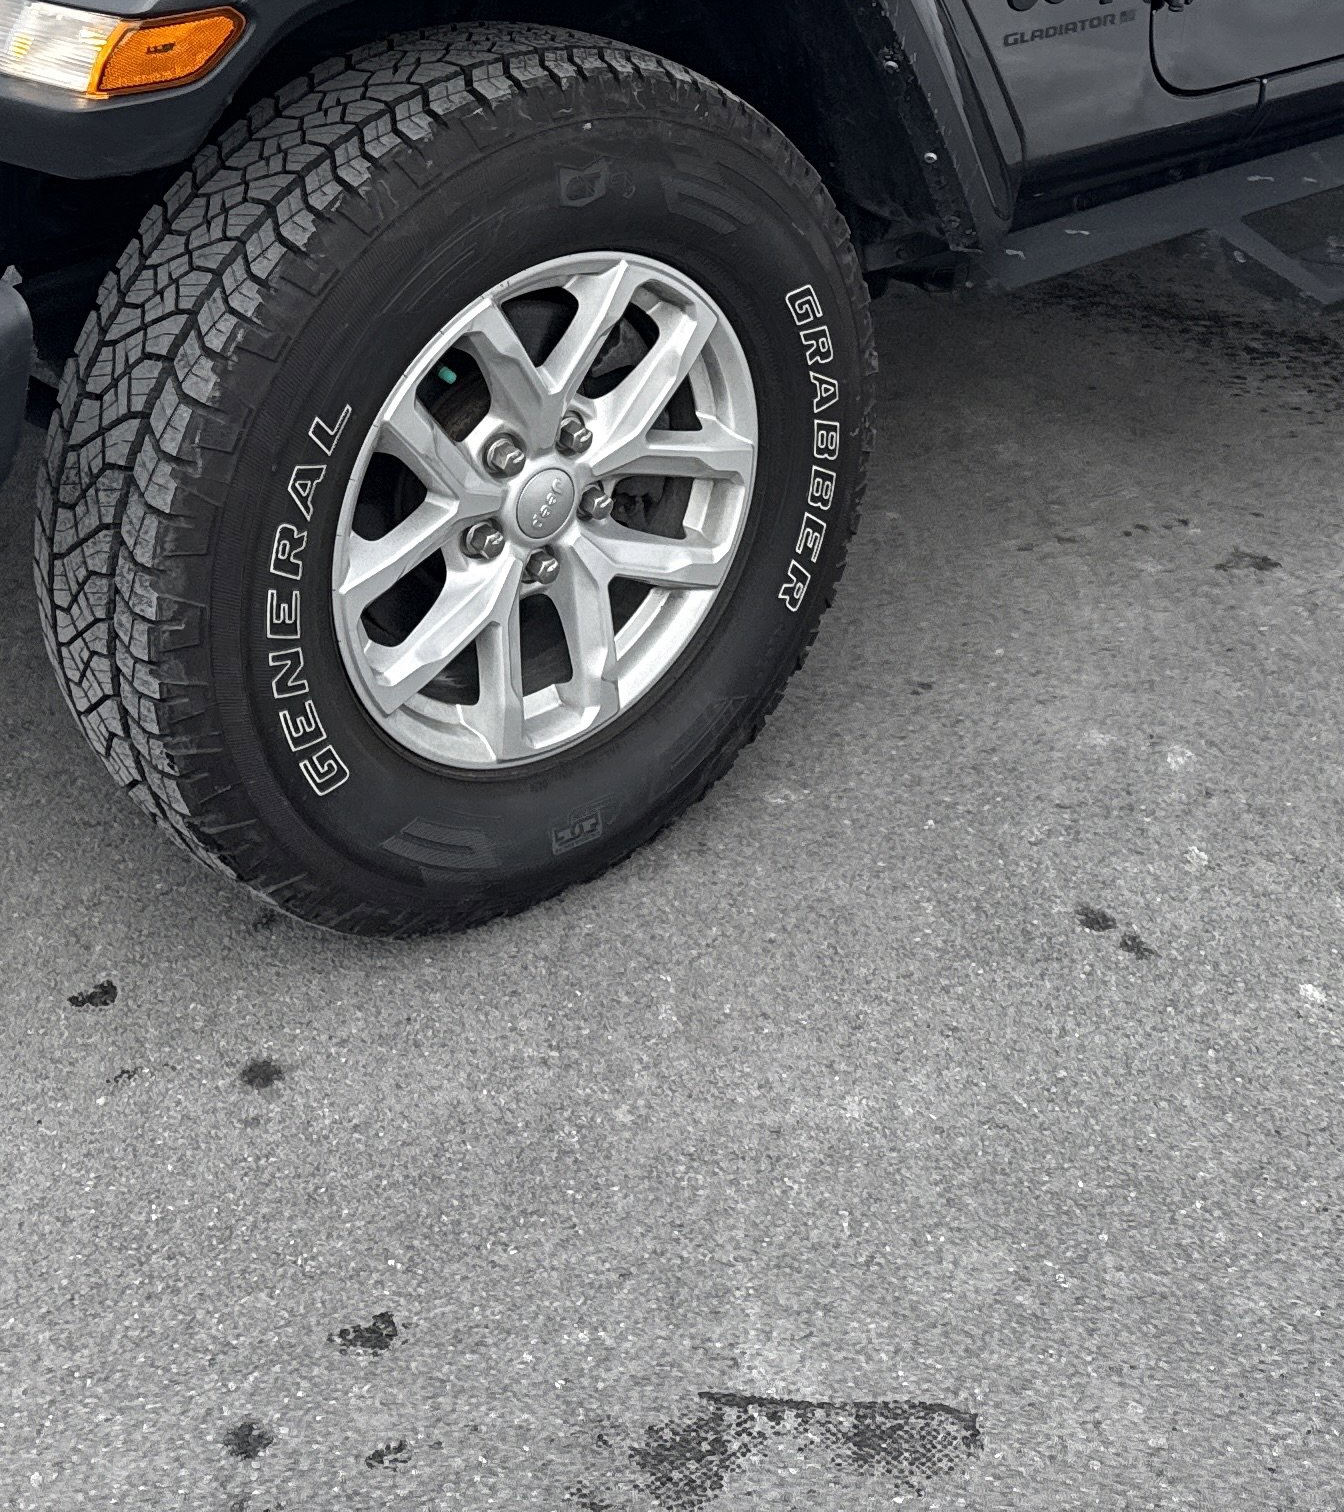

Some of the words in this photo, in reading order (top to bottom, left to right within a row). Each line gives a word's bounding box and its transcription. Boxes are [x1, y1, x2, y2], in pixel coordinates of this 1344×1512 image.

[1003, 13, 1116, 47] GLADIATOR
[532, 477, 563, 529] Jeep
[778, 284, 840, 613] GRABBER
[266, 404, 352, 797] GENERAL
